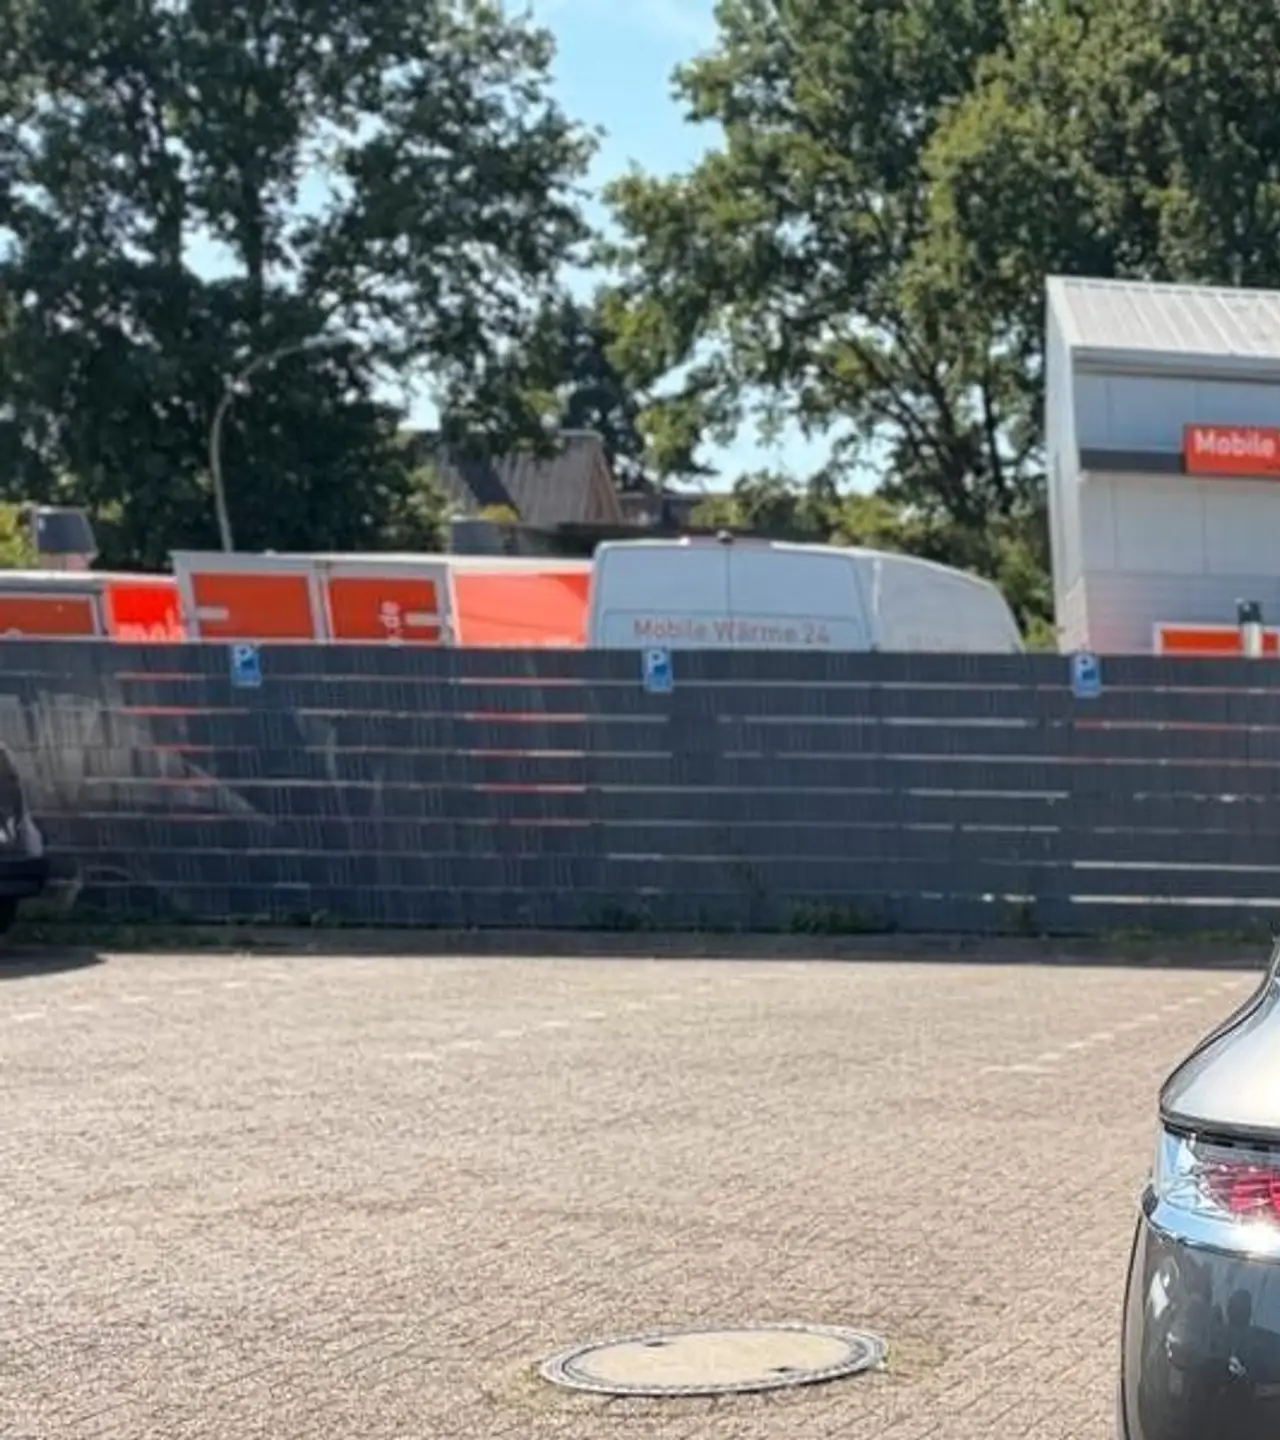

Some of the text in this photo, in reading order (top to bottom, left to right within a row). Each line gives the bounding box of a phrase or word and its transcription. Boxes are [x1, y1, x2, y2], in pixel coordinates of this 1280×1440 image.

[1193, 428, 1276, 458] Mobile
[633, 617, 831, 645] Mobile Wärme 24
